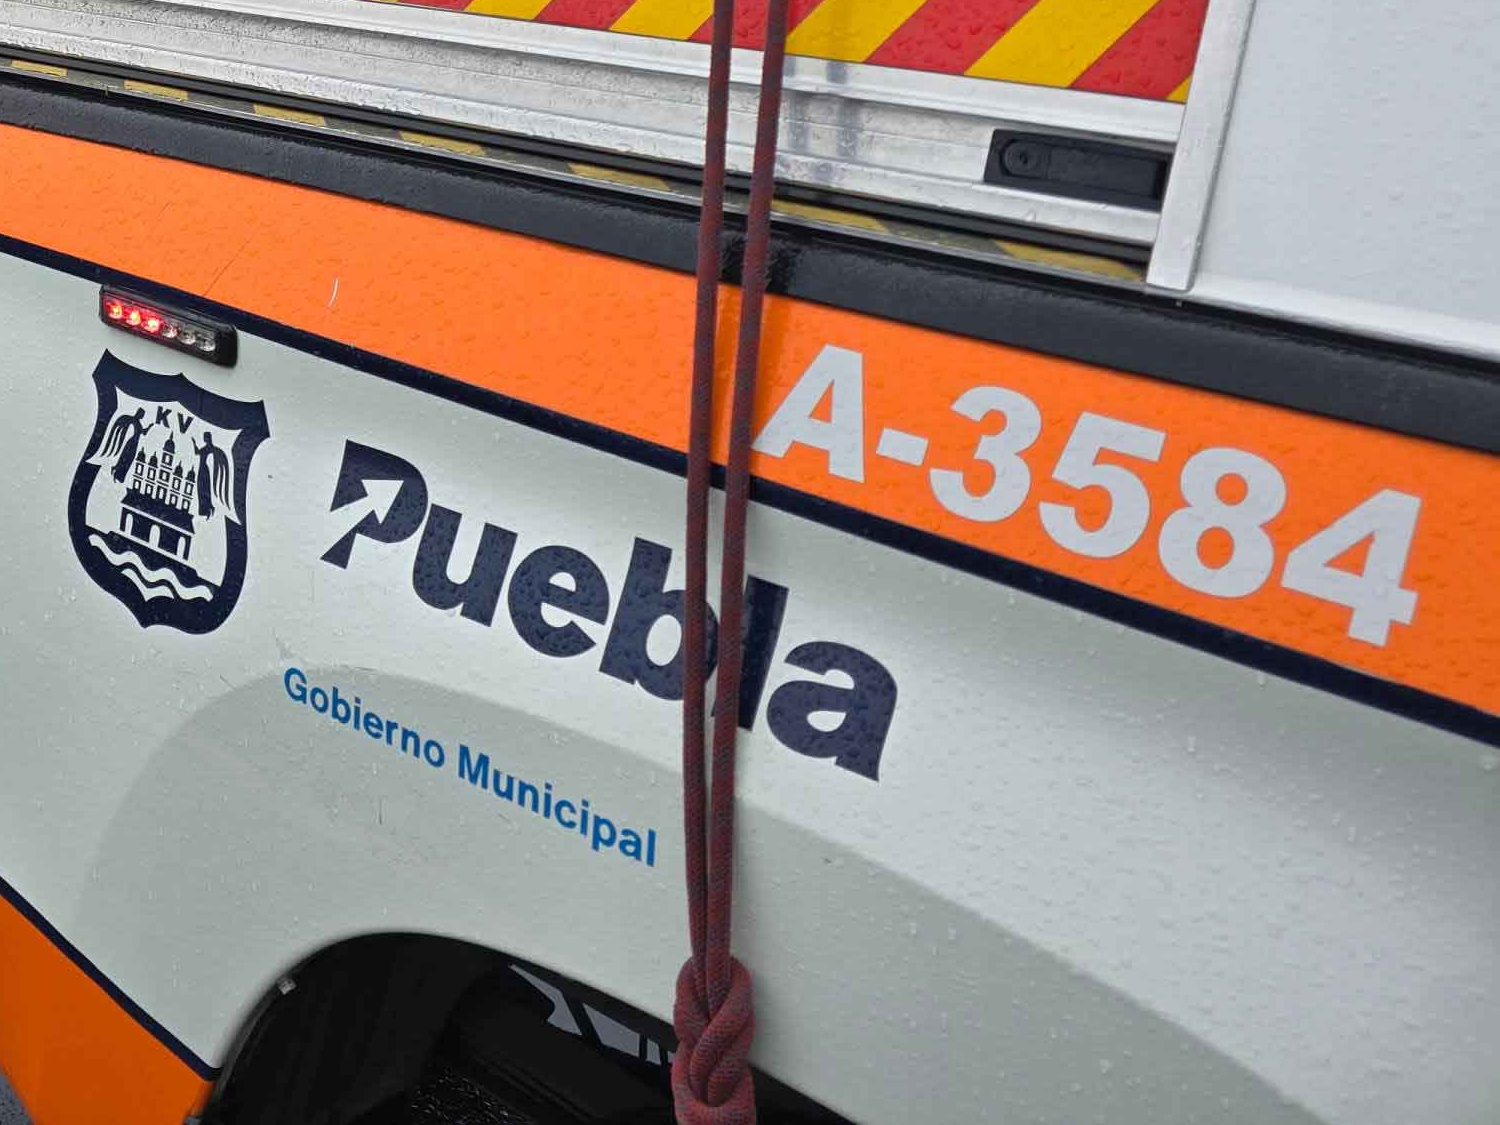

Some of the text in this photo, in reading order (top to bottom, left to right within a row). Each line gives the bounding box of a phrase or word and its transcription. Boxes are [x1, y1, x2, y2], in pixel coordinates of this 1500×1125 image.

[320, 439, 898, 782] Puebla
[750, 344, 1422, 648] A-3584
[283, 667, 657, 868] Gobierno Municipal
